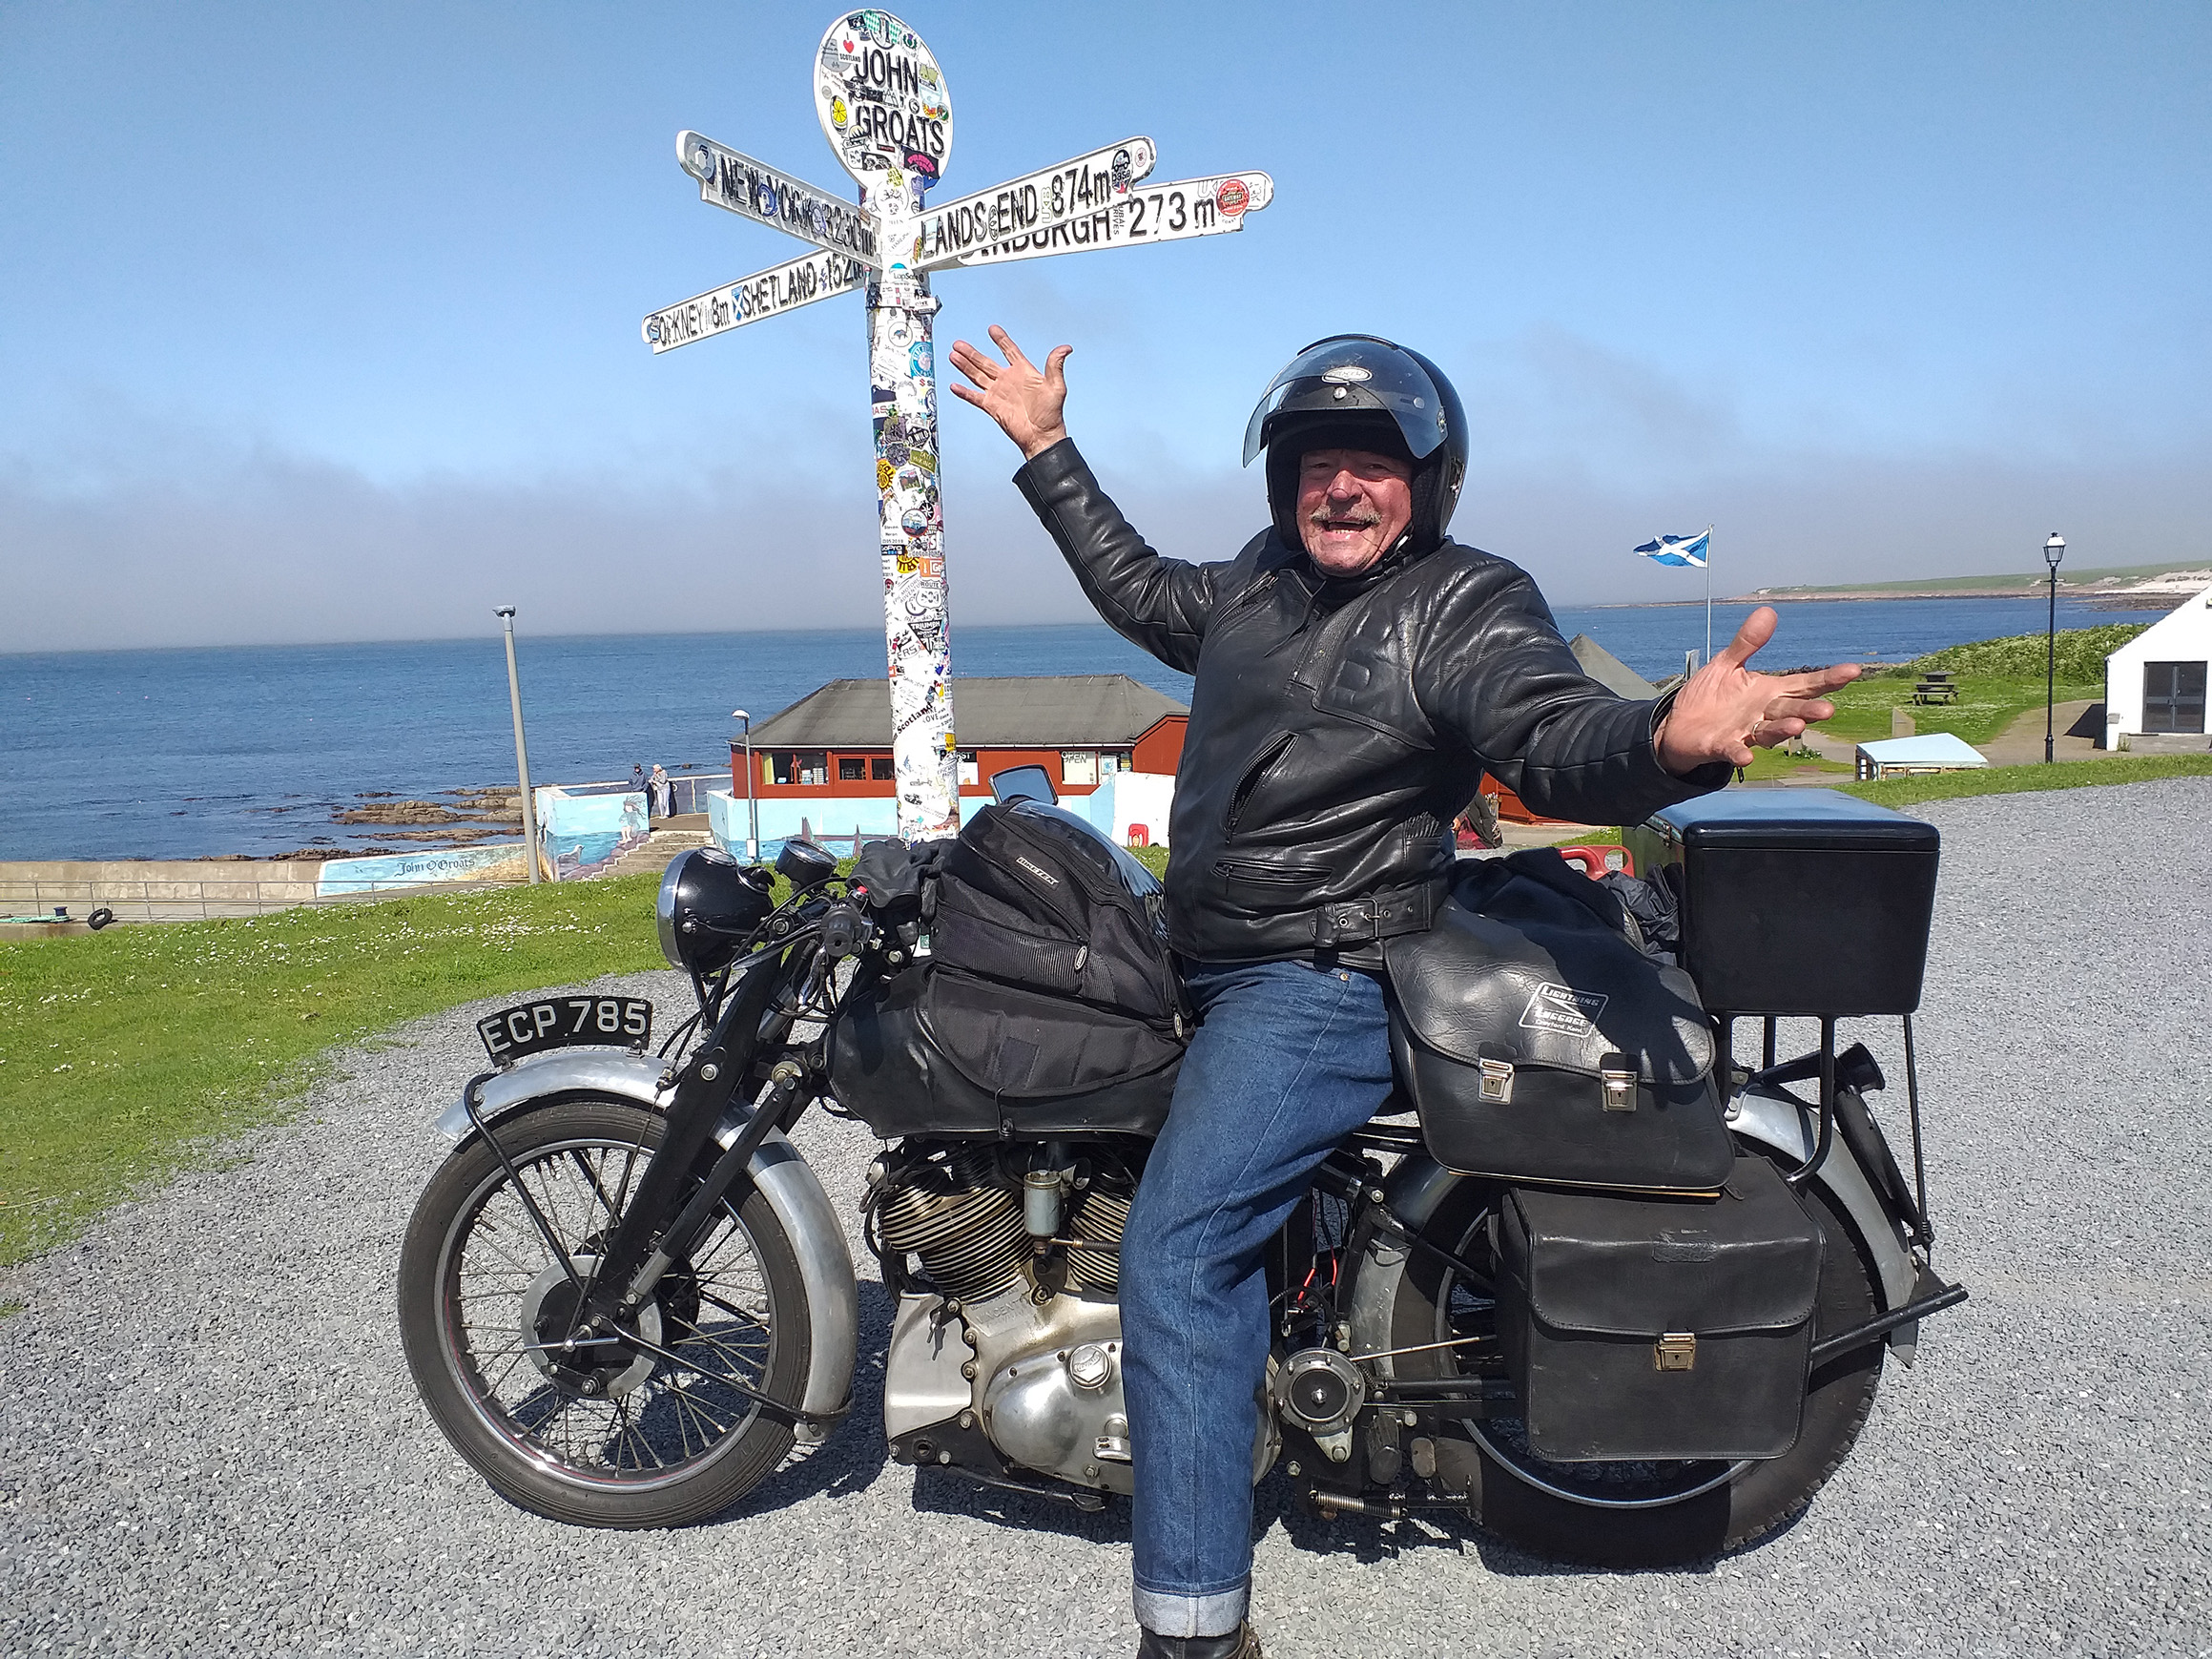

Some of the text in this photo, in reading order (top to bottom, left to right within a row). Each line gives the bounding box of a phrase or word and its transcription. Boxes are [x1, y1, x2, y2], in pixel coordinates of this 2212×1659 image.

[839, 52, 861, 63] SCOTLAND
[855, 46, 919, 96] JOHN
[856, 105, 944, 156] GROATS
[720, 154, 762, 215] NEW
[920, 200, 986, 259] LANDS
[997, 184, 1040, 234] END
[1051, 164, 1111, 218] 874m
[1129, 191, 1188, 238] 273
[741, 260, 817, 319] SHETLAND
[910, 621, 941, 630] TRIUMPH
[897, 701, 933, 735] Scotland
[1061, 751, 1086, 760] OPEN
[394, 858, 475, 877] John O'Groats
[1540, 985, 1601, 1006] LIGHTNING
[480, 1001, 647, 1054] ECP 785
[1534, 1007, 1588, 1027] LUGGAGE
